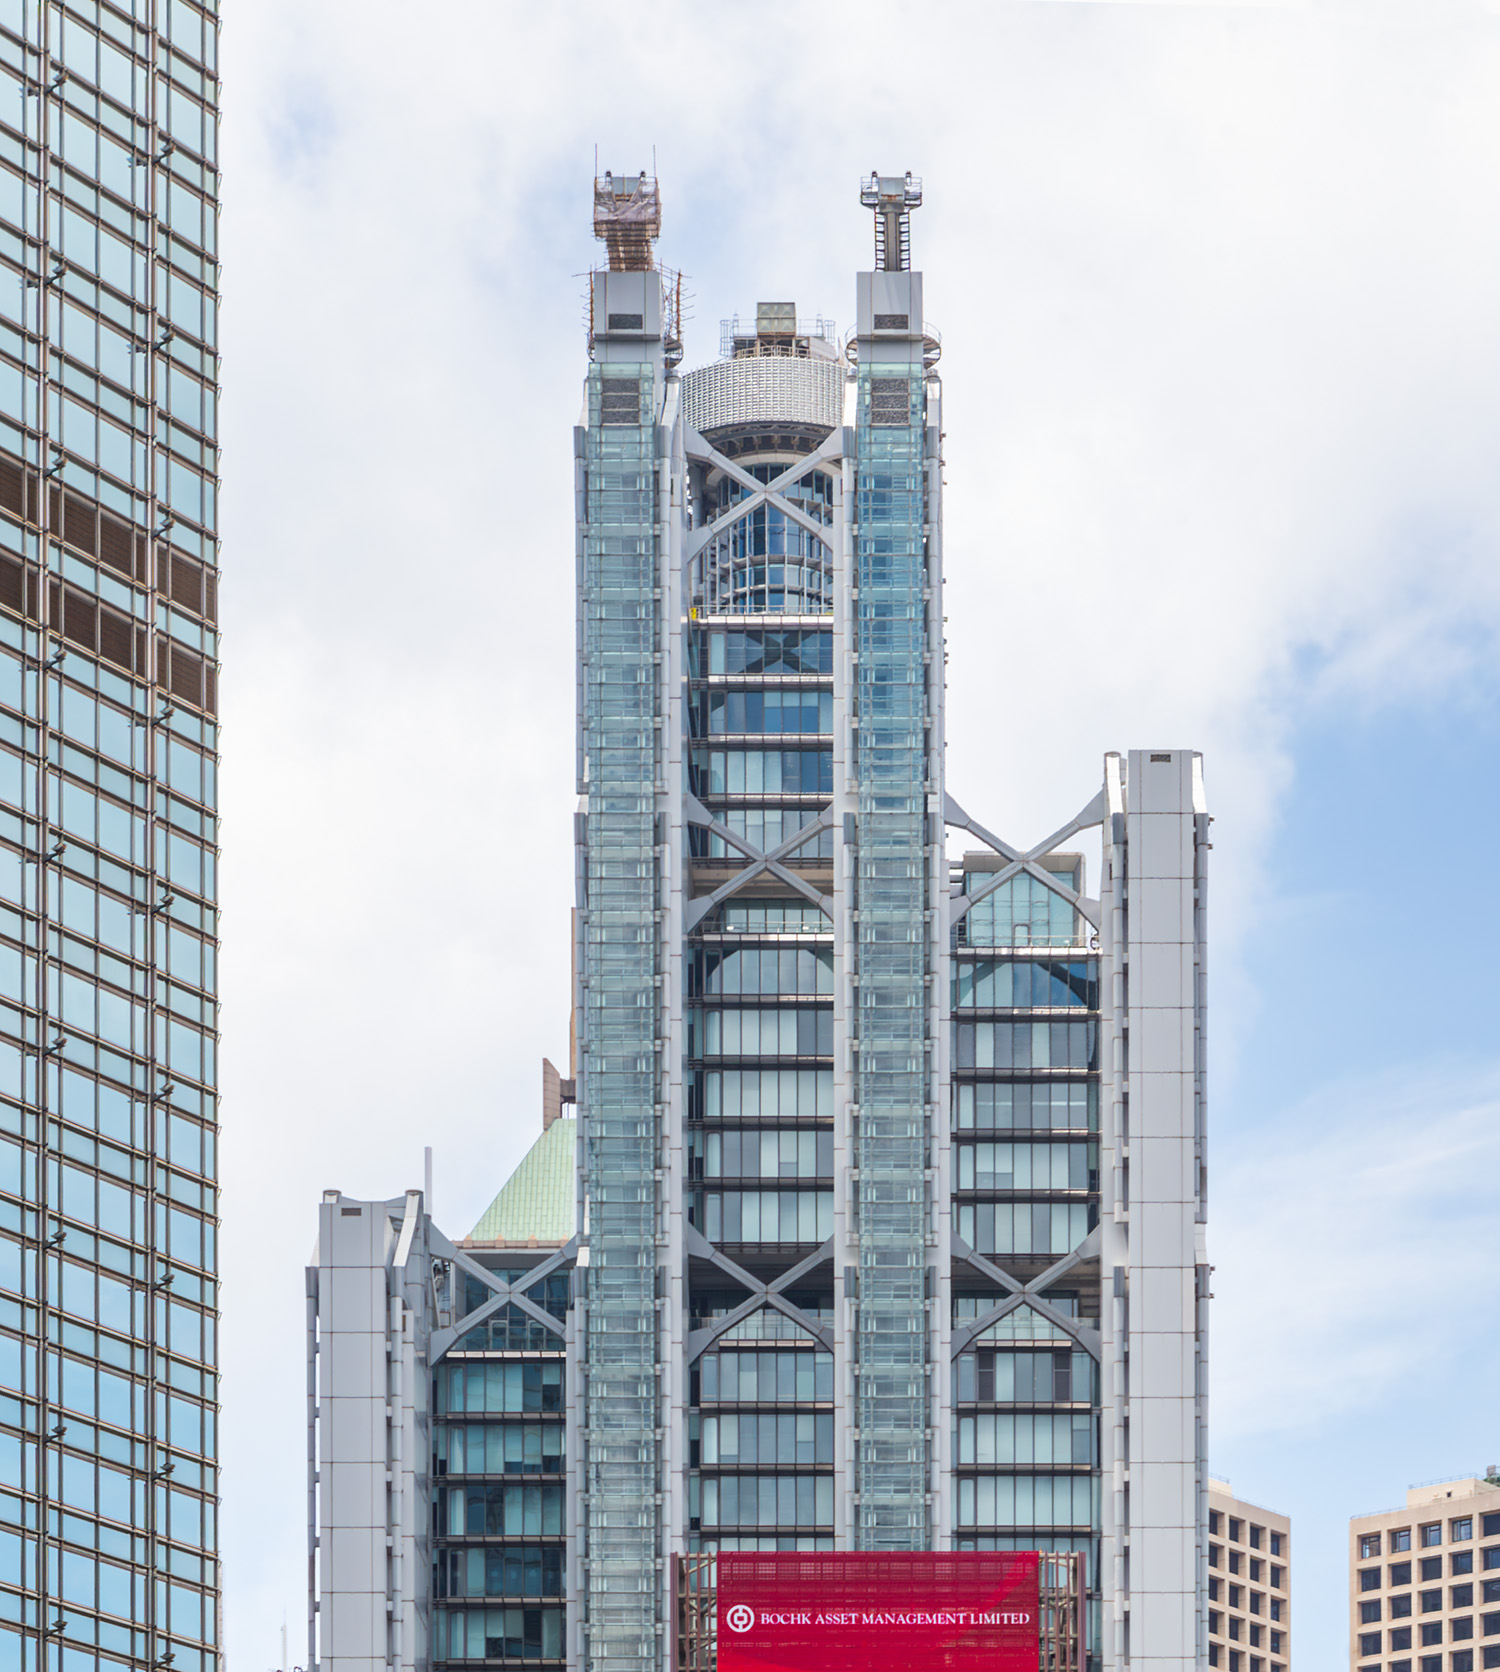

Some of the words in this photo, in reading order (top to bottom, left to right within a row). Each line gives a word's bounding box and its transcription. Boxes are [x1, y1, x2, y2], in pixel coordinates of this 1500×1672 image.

[761, 1613, 811, 1625] BOCHK
[815, 1613, 858, 1625] ASSET
[862, 1613, 966, 1625] MANAGEMENT
[970, 1613, 1030, 1625] LIMITED
